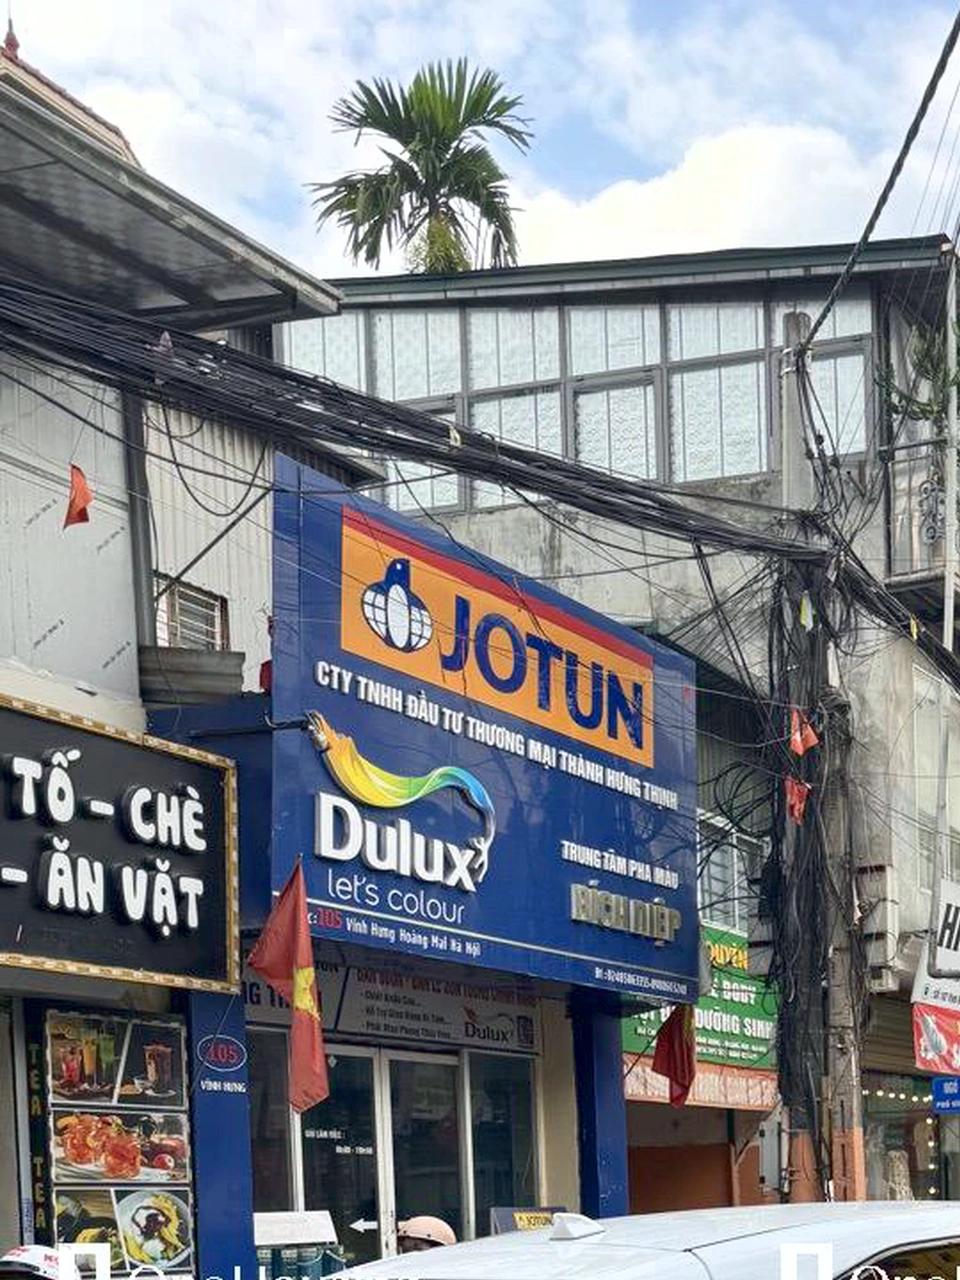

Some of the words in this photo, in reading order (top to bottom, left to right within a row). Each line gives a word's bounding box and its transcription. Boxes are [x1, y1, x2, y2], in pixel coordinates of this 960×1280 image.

[440, 595, 643, 750] JOTUN
[315, 661, 352, 695] CTY
[357, 675, 402, 712] TNHH
[406, 690, 439, 726] ĐẦU
[442, 706, 465, 735] TƯ
[466, 715, 526, 756] THƯƠNG
[528, 739, 557, 770] MẠI
[559, 749, 604, 785] THÀNH
[605, 767, 642, 800] HƯNG
[13, 749, 81, 823] TỐ
[130, 785, 208, 851] CHÈ
[316, 792, 477, 893] Dulux
[560, 840, 601, 865] TRUNG
[603, 848, 627, 876] TÂM
[628, 859, 652, 883] PHA
[47, 836, 105, 914] ĂN
[121, 858, 204, 937] VẶT
[328, 868, 380, 906] let's
[387, 890, 465, 924] colour
[207, 1042, 238, 1064] 105
[464, 1021, 510, 1043] Dulux
[200, 1077, 221, 1091] VĨNH
[223, 1080, 246, 1093] HƯNG
